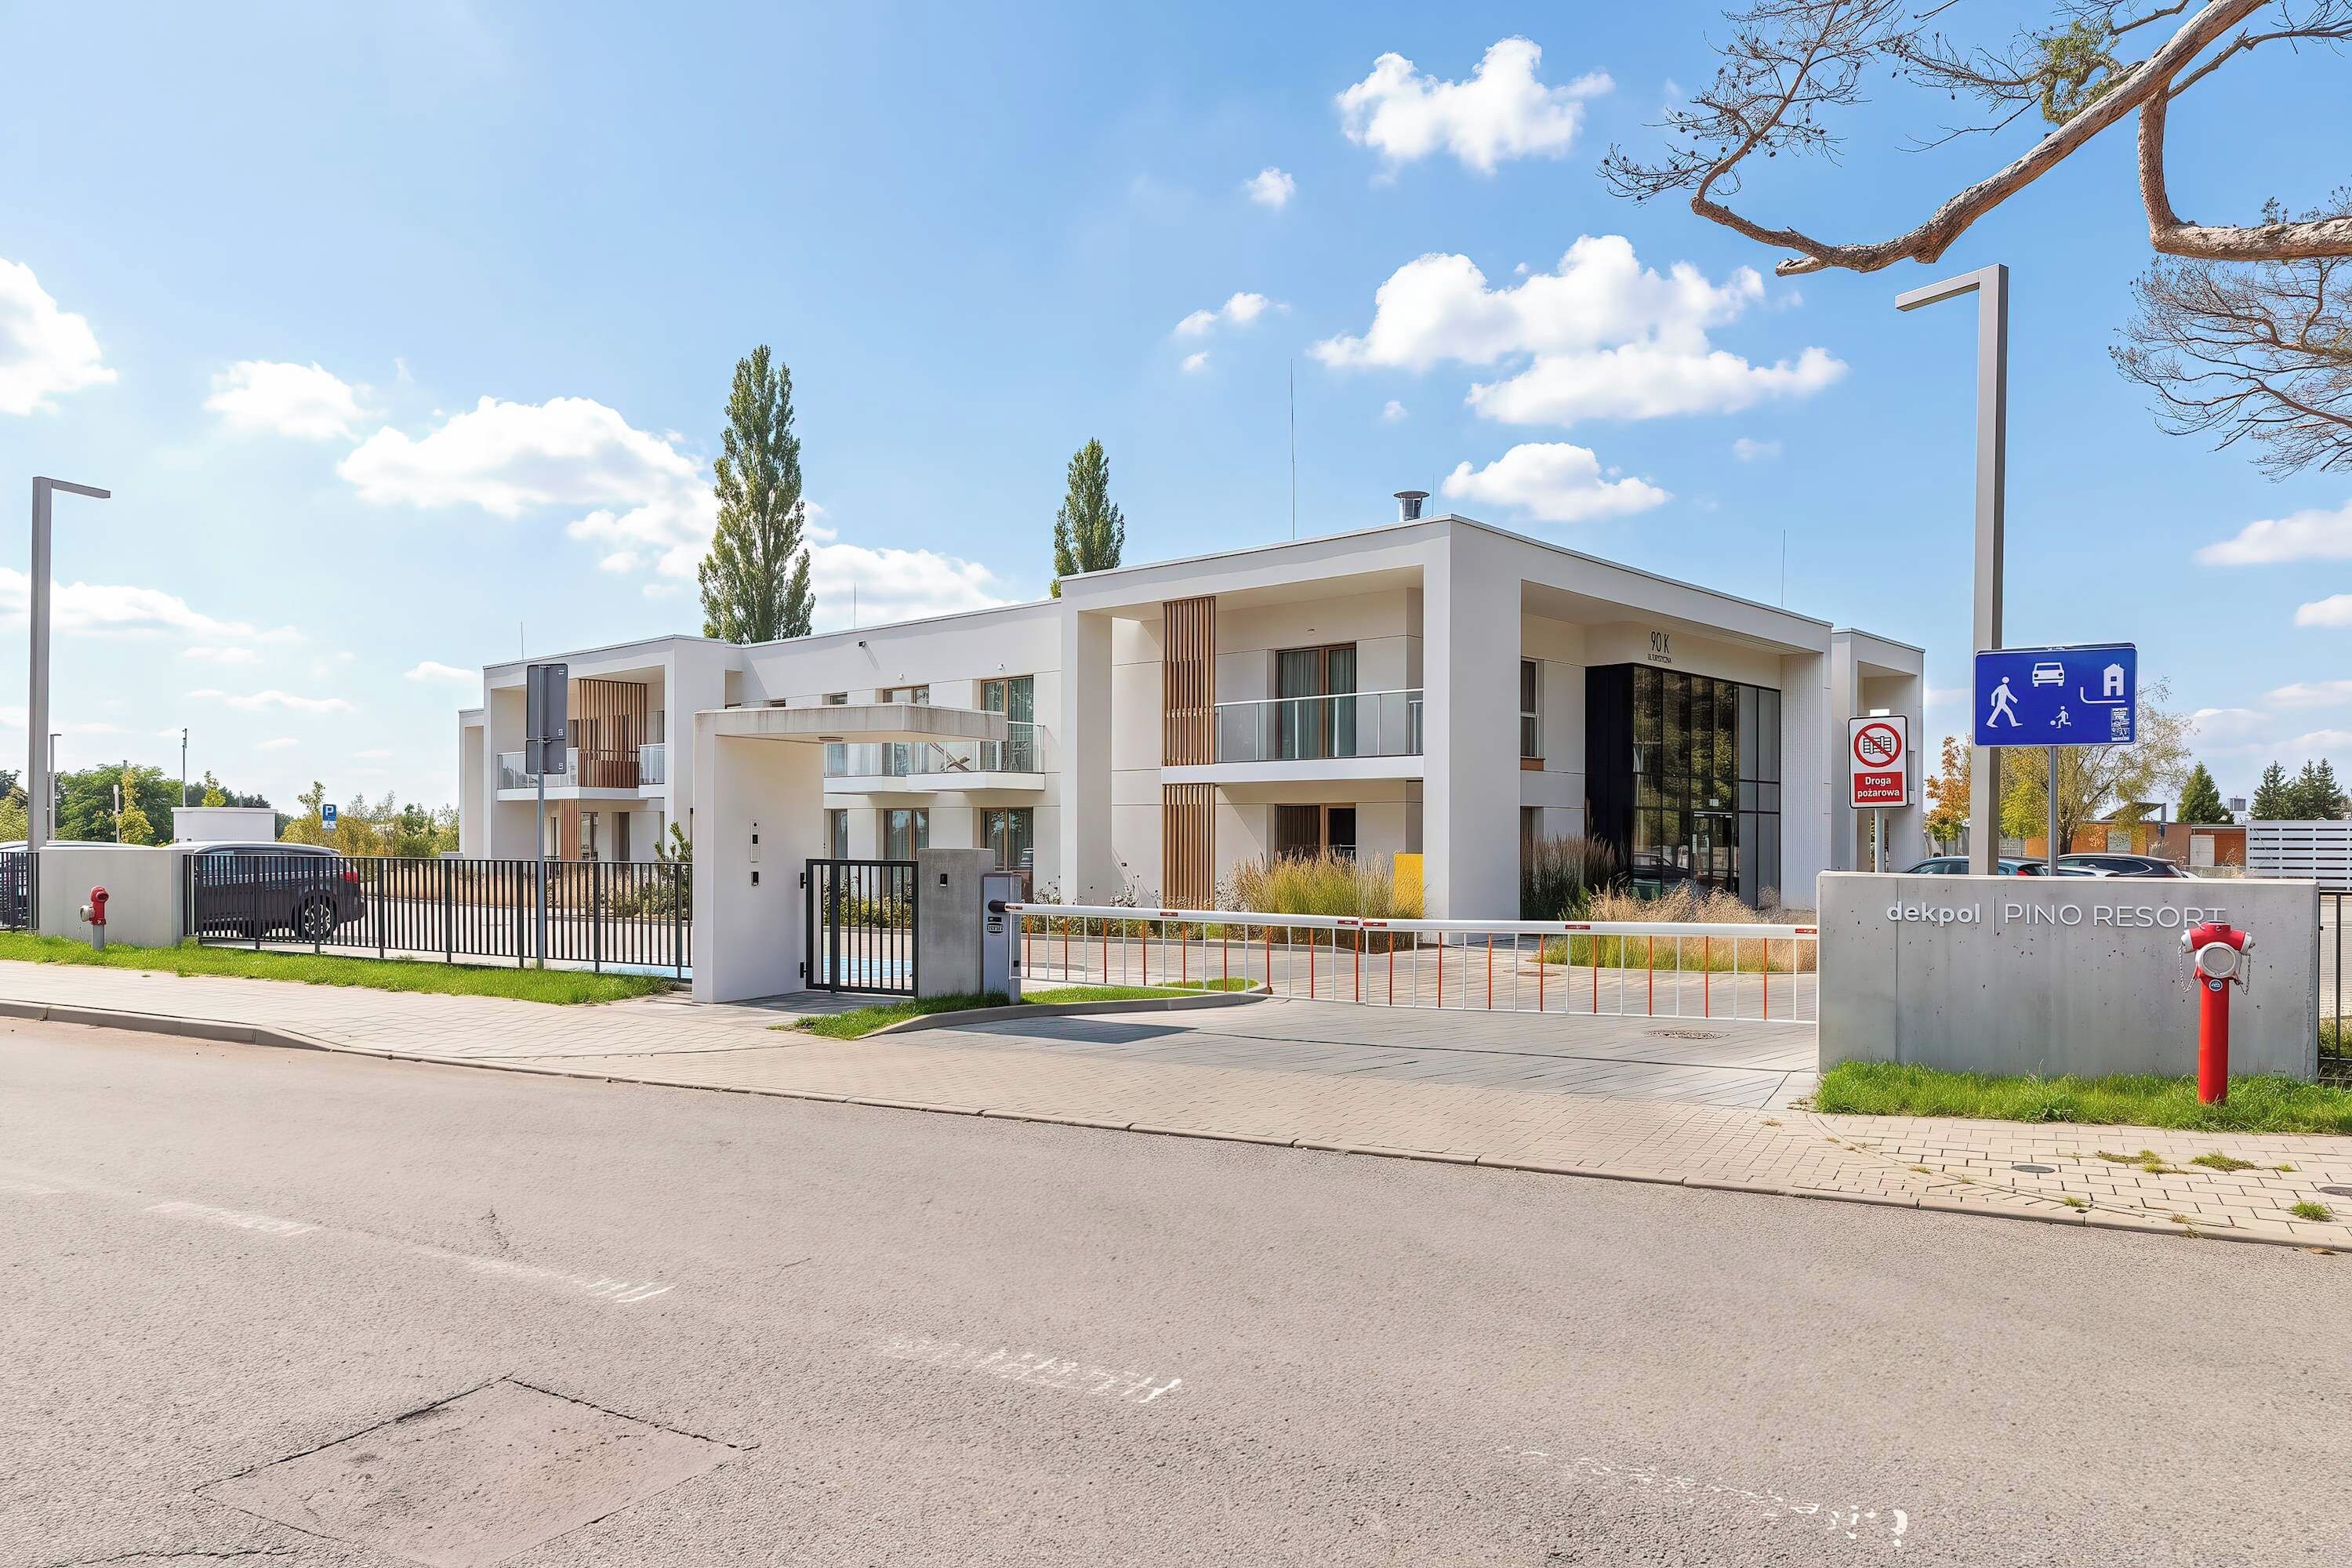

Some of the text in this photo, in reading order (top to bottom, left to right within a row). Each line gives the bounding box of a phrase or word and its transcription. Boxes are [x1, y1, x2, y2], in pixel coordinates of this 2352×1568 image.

[1651, 631, 1670, 654] 90 K
[1864, 776, 1892, 786] Droga
[1857, 788, 1900, 800] pożarowa
[325, 805, 334, 816] P
[1886, 901, 2227, 929] dekpol PINO RESORT
